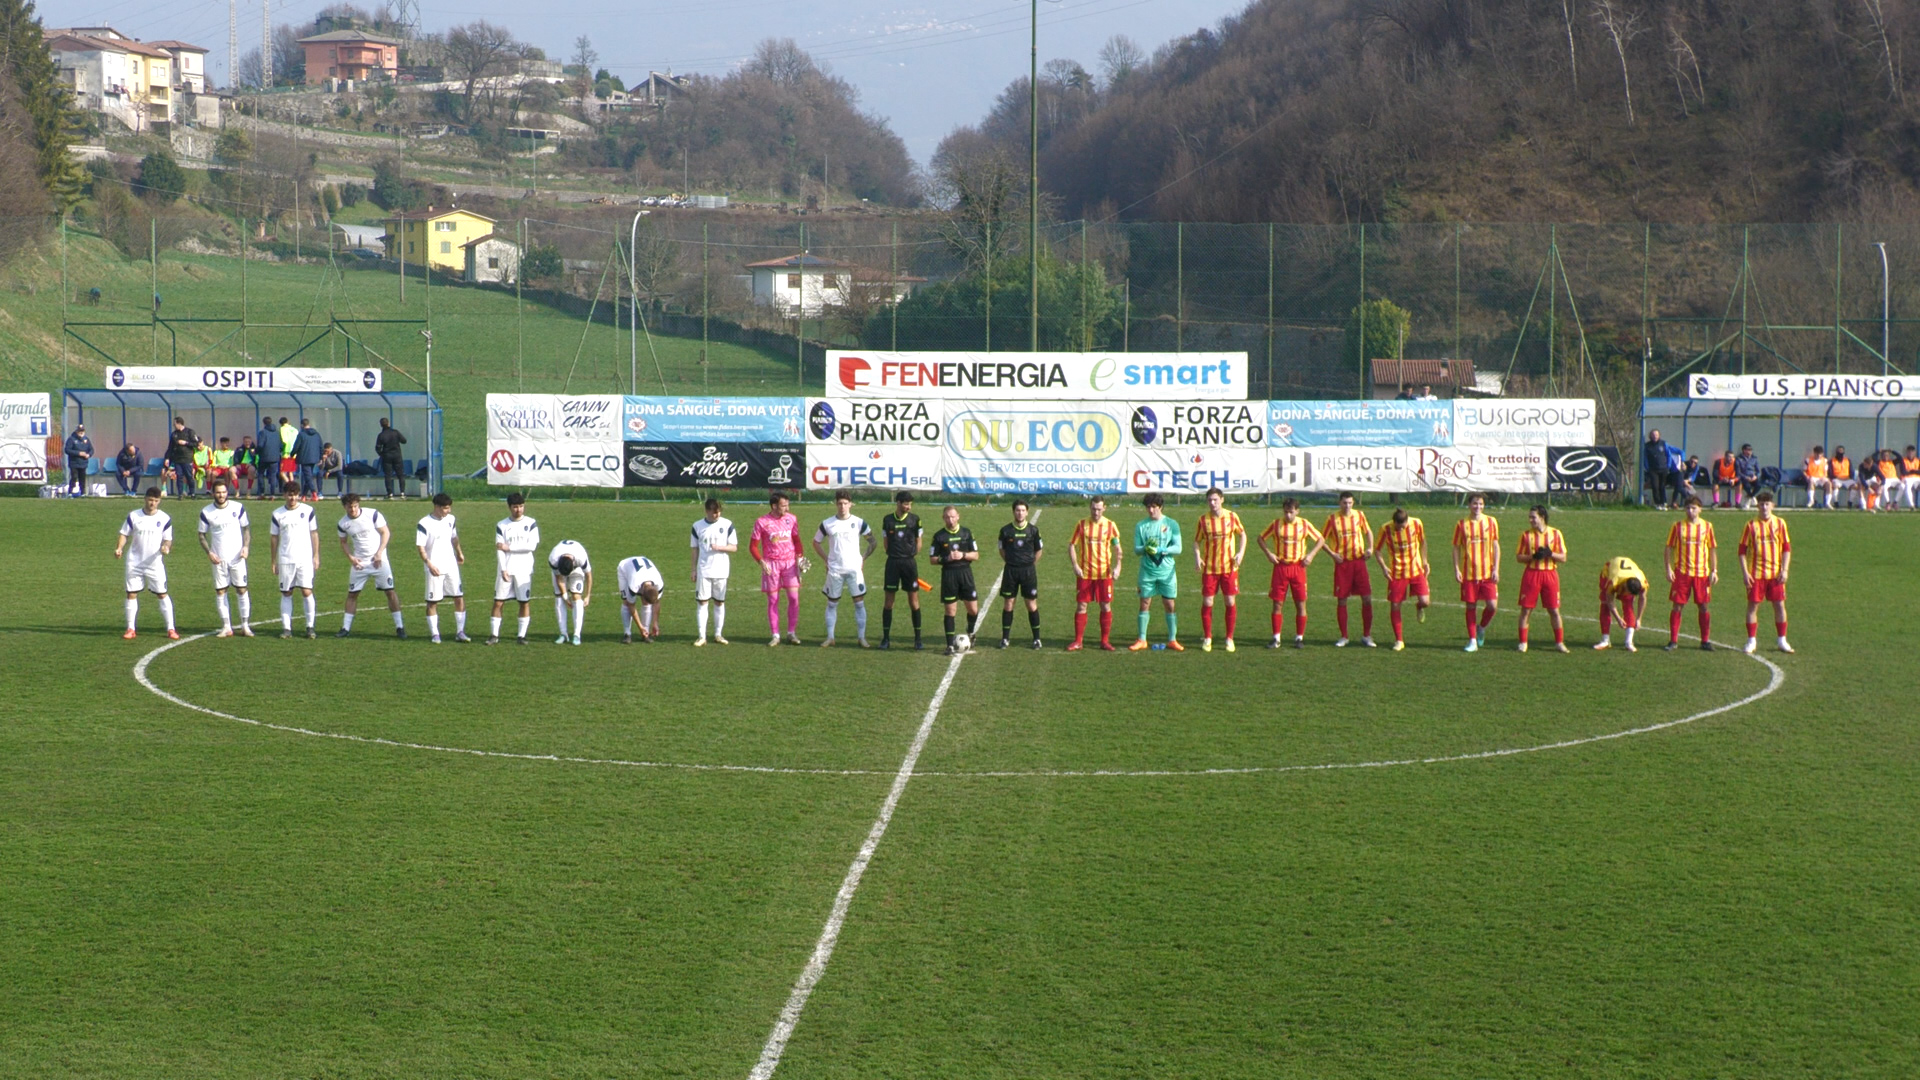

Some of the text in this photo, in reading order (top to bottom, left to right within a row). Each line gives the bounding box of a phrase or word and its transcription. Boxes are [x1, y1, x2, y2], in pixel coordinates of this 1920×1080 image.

[203, 370, 274, 388] OSPITI
[882, 362, 1068, 387] FENENERGIA
[1124, 360, 1232, 385] smart
[1753, 378, 1904, 397] U.S. PIANICO
[562, 400, 610, 412] CANINI
[625, 403, 800, 417] DONA SANGUE, DONA VITA
[851, 402, 930, 421] FORZA
[506, 409, 548, 420] SOLTO
[562, 415, 601, 428] CARS
[1173, 405, 1253, 425] FORZA
[1272, 408, 1450, 421] DONA SANGUE, DONA VITA
[1465, 408, 1591, 425] BUSIGROUP
[500, 419, 555, 429] COLLINA
[840, 422, 940, 441] PIANICO
[962, 418, 1104, 453] DU.ECO
[1162, 425, 1264, 445] PIANICO
[1464, 430, 1501, 439] dynamic
[1504, 430, 1549, 439] integrated
[703, 446, 729, 461] Bar
[1487, 453, 1541, 464] trattoria
[518, 454, 621, 471] MALECO
[680, 461, 749, 479] AMOCO
[979, 462, 1095, 473] SERVIZI ECOLOGICI
[1317, 456, 1403, 470] IRISHOTEL
[4, 468, 42, 479] PACIO
[811, 466, 937, 485] GTECH SRL
[1133, 470, 1259, 489] GTECH SRL
[978, 480, 1015, 492] Volpino
[1017, 481, 1039, 492] (Bg)
[1047, 482, 1064, 491] Tel.
[1620, 560, 1632, 570] 7
